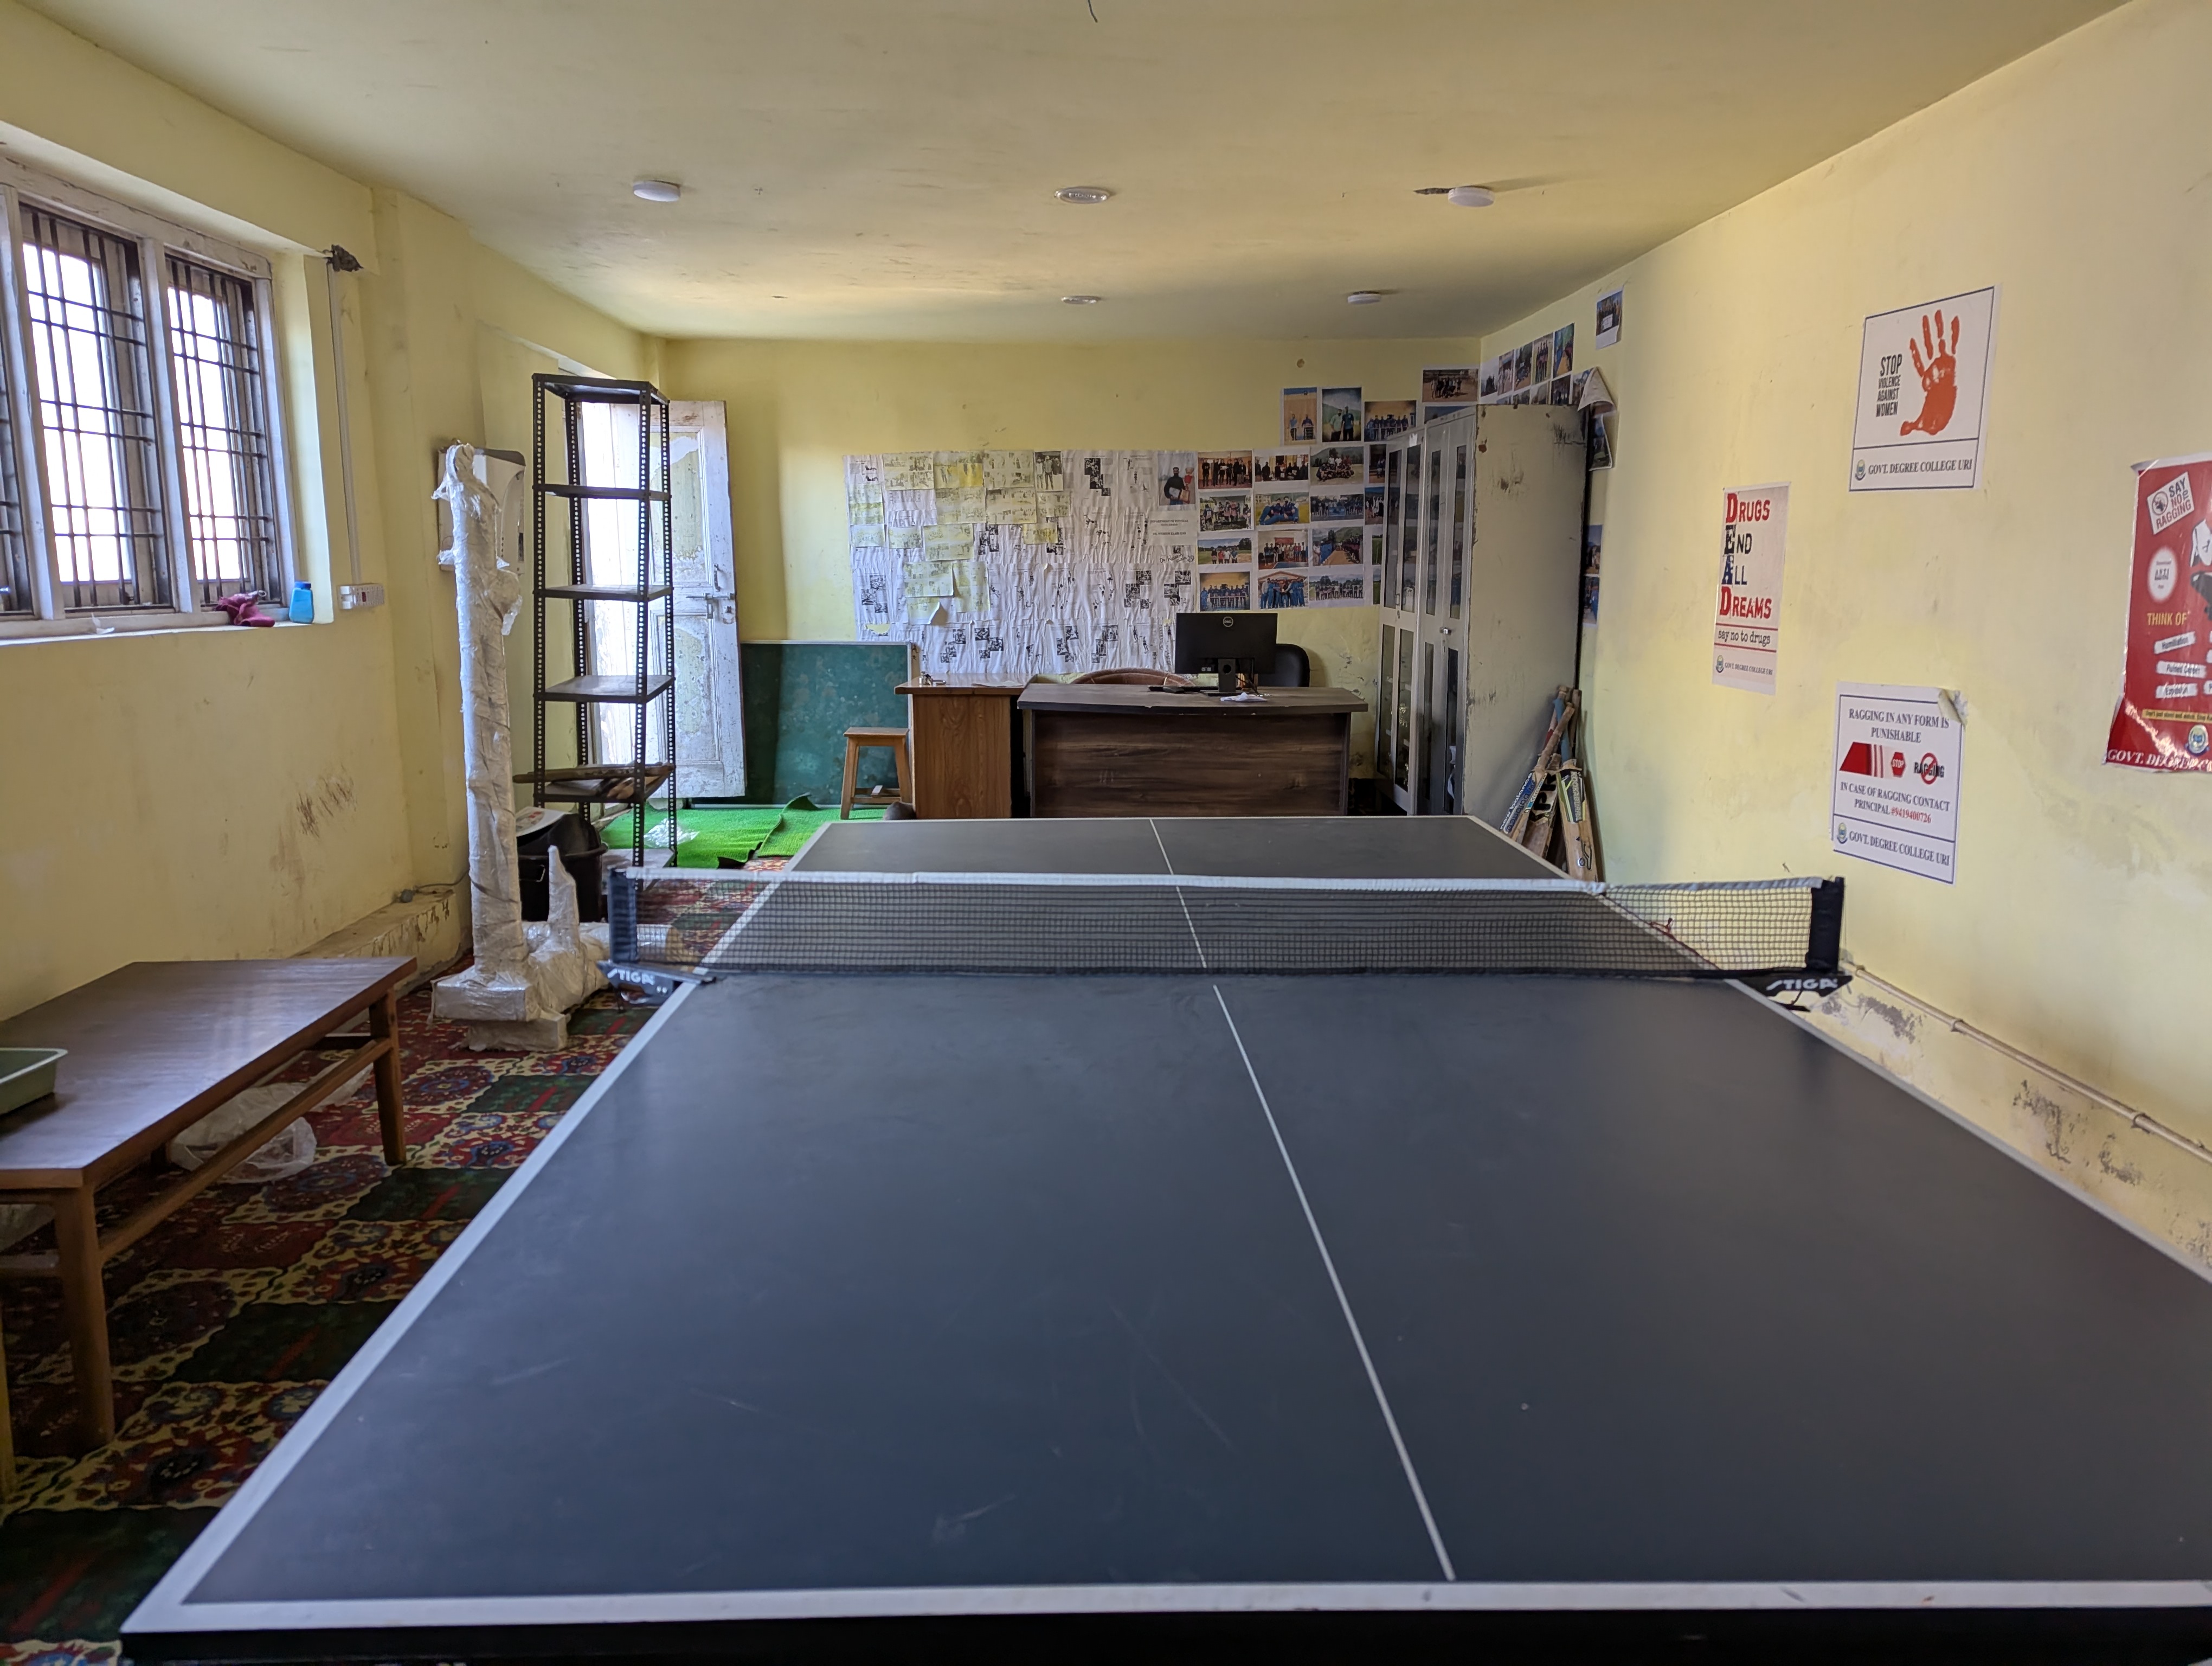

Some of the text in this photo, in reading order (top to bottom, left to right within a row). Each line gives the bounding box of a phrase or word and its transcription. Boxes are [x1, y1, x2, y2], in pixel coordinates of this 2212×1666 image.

[1880, 354, 1902, 376] STOP
[1878, 375, 1901, 389] VIOLENCE
[1877, 388, 1900, 402] AGAINST
[1876, 401, 1898, 417] WOMEN
[1868, 459, 1973, 475] GOVT. DEGREE COLLEGE URI
[2169, 477, 2185, 498] SAY
[1726, 493, 1771, 523] DRUGS
[2171, 494, 2182, 508] NO
[2156, 499, 2191, 529] RAGGING
[1725, 524, 1752, 554] END
[1721, 555, 1747, 585] ALL
[1720, 586, 1772, 619] DREAMS
[2147, 612, 2188, 626] THINK OF
[1718, 630, 1771, 647] say no to drugs
[1849, 708, 1950, 728] RAGGING IN ANY FORM IS
[1871, 727, 1921, 743] PUNISHABLE
[1892, 759, 1905, 768] STOP
[2107, 749, 2144, 764] GOVT.
[1500, 773, 1533, 829] new balance
[1840, 781, 1951, 811] IN CASE OF RAGGING CONTACT
[1854, 798, 1891, 815] PRINCIPAL
[1849, 830, 1950, 866] GOVT. DEGREE COLLEGE URI
[607, 969, 655, 985] STIGA
[1766, 978, 1838, 991] STIGA
